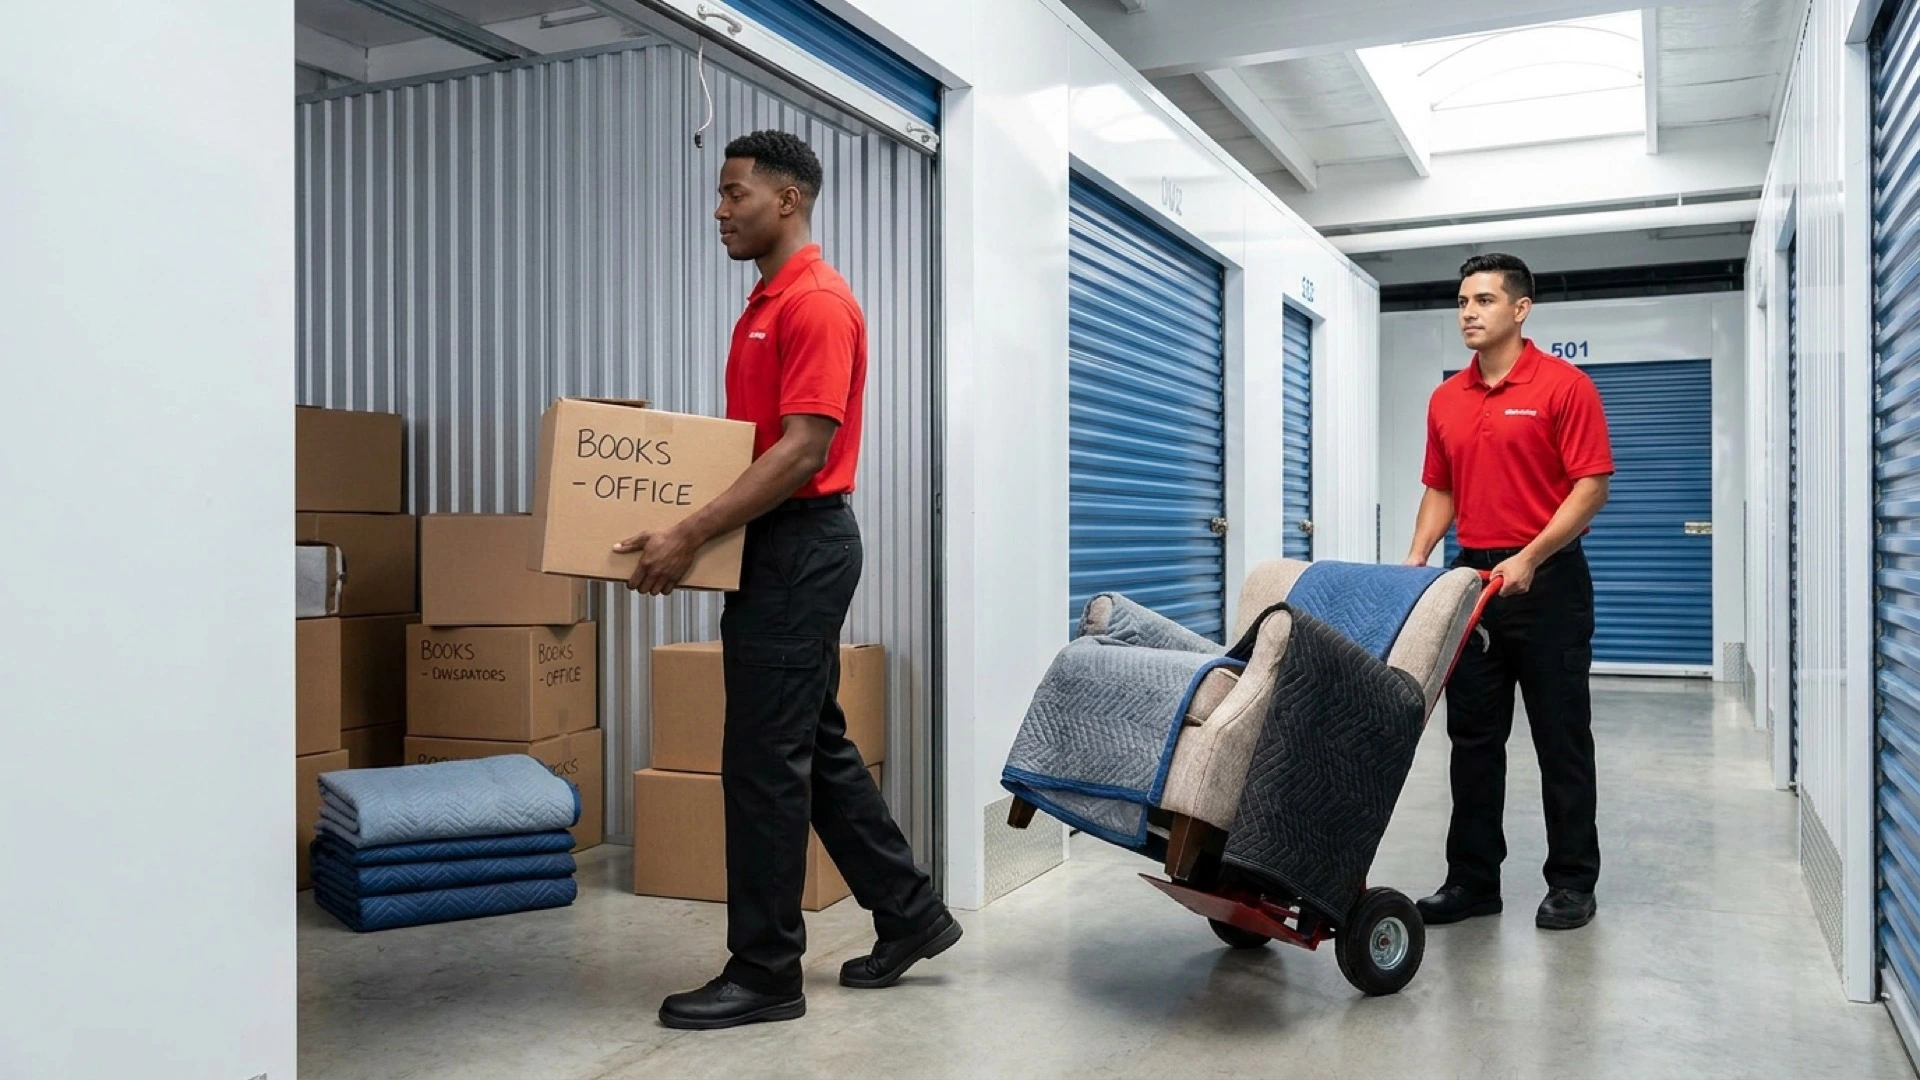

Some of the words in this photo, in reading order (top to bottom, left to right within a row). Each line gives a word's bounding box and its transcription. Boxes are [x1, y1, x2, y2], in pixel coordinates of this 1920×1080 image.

[1551, 340, 1588, 359] 501
[577, 428, 672, 465] BOOKS
[420, 639, 475, 661] BOOKS
